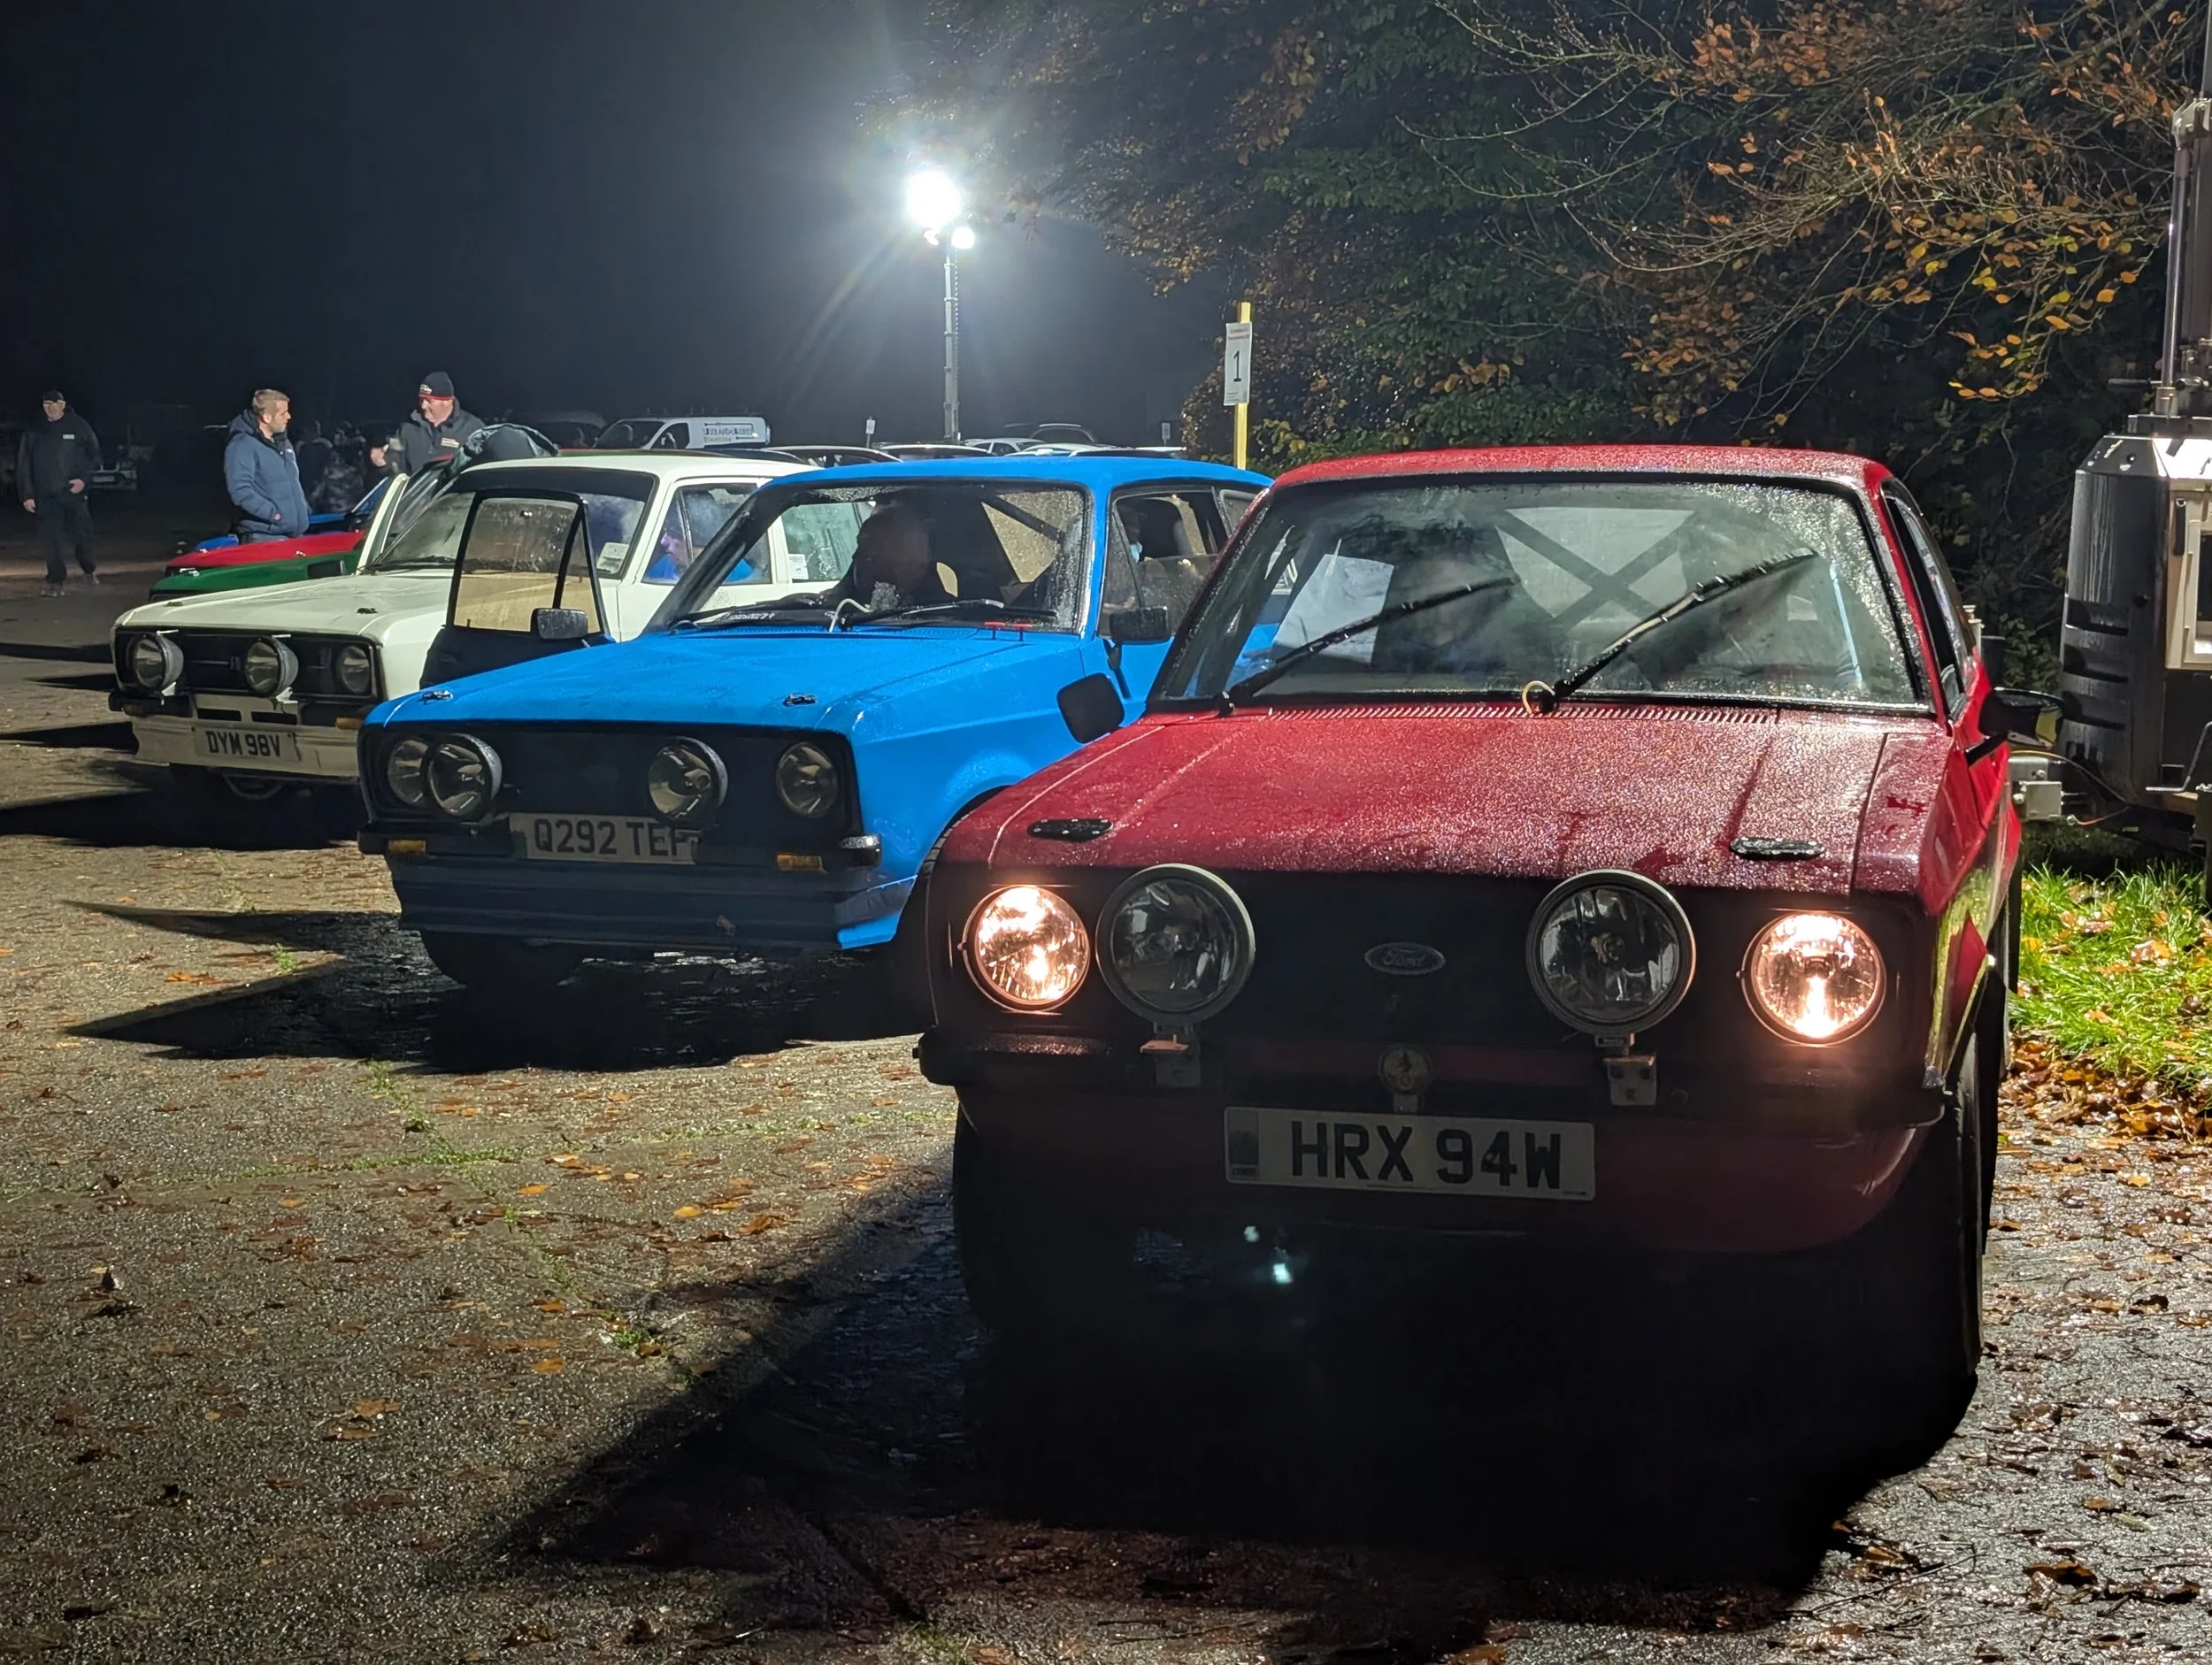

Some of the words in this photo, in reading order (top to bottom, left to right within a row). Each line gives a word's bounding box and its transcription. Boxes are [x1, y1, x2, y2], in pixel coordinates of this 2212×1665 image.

[1233, 349, 1242, 382] 1
[205, 730, 243, 756] DYM
[244, 733, 280, 757] 98V
[534, 818, 618, 855] Q292
[1291, 1120, 1414, 1183] HRX
[1435, 1128, 1562, 1190] 94W
